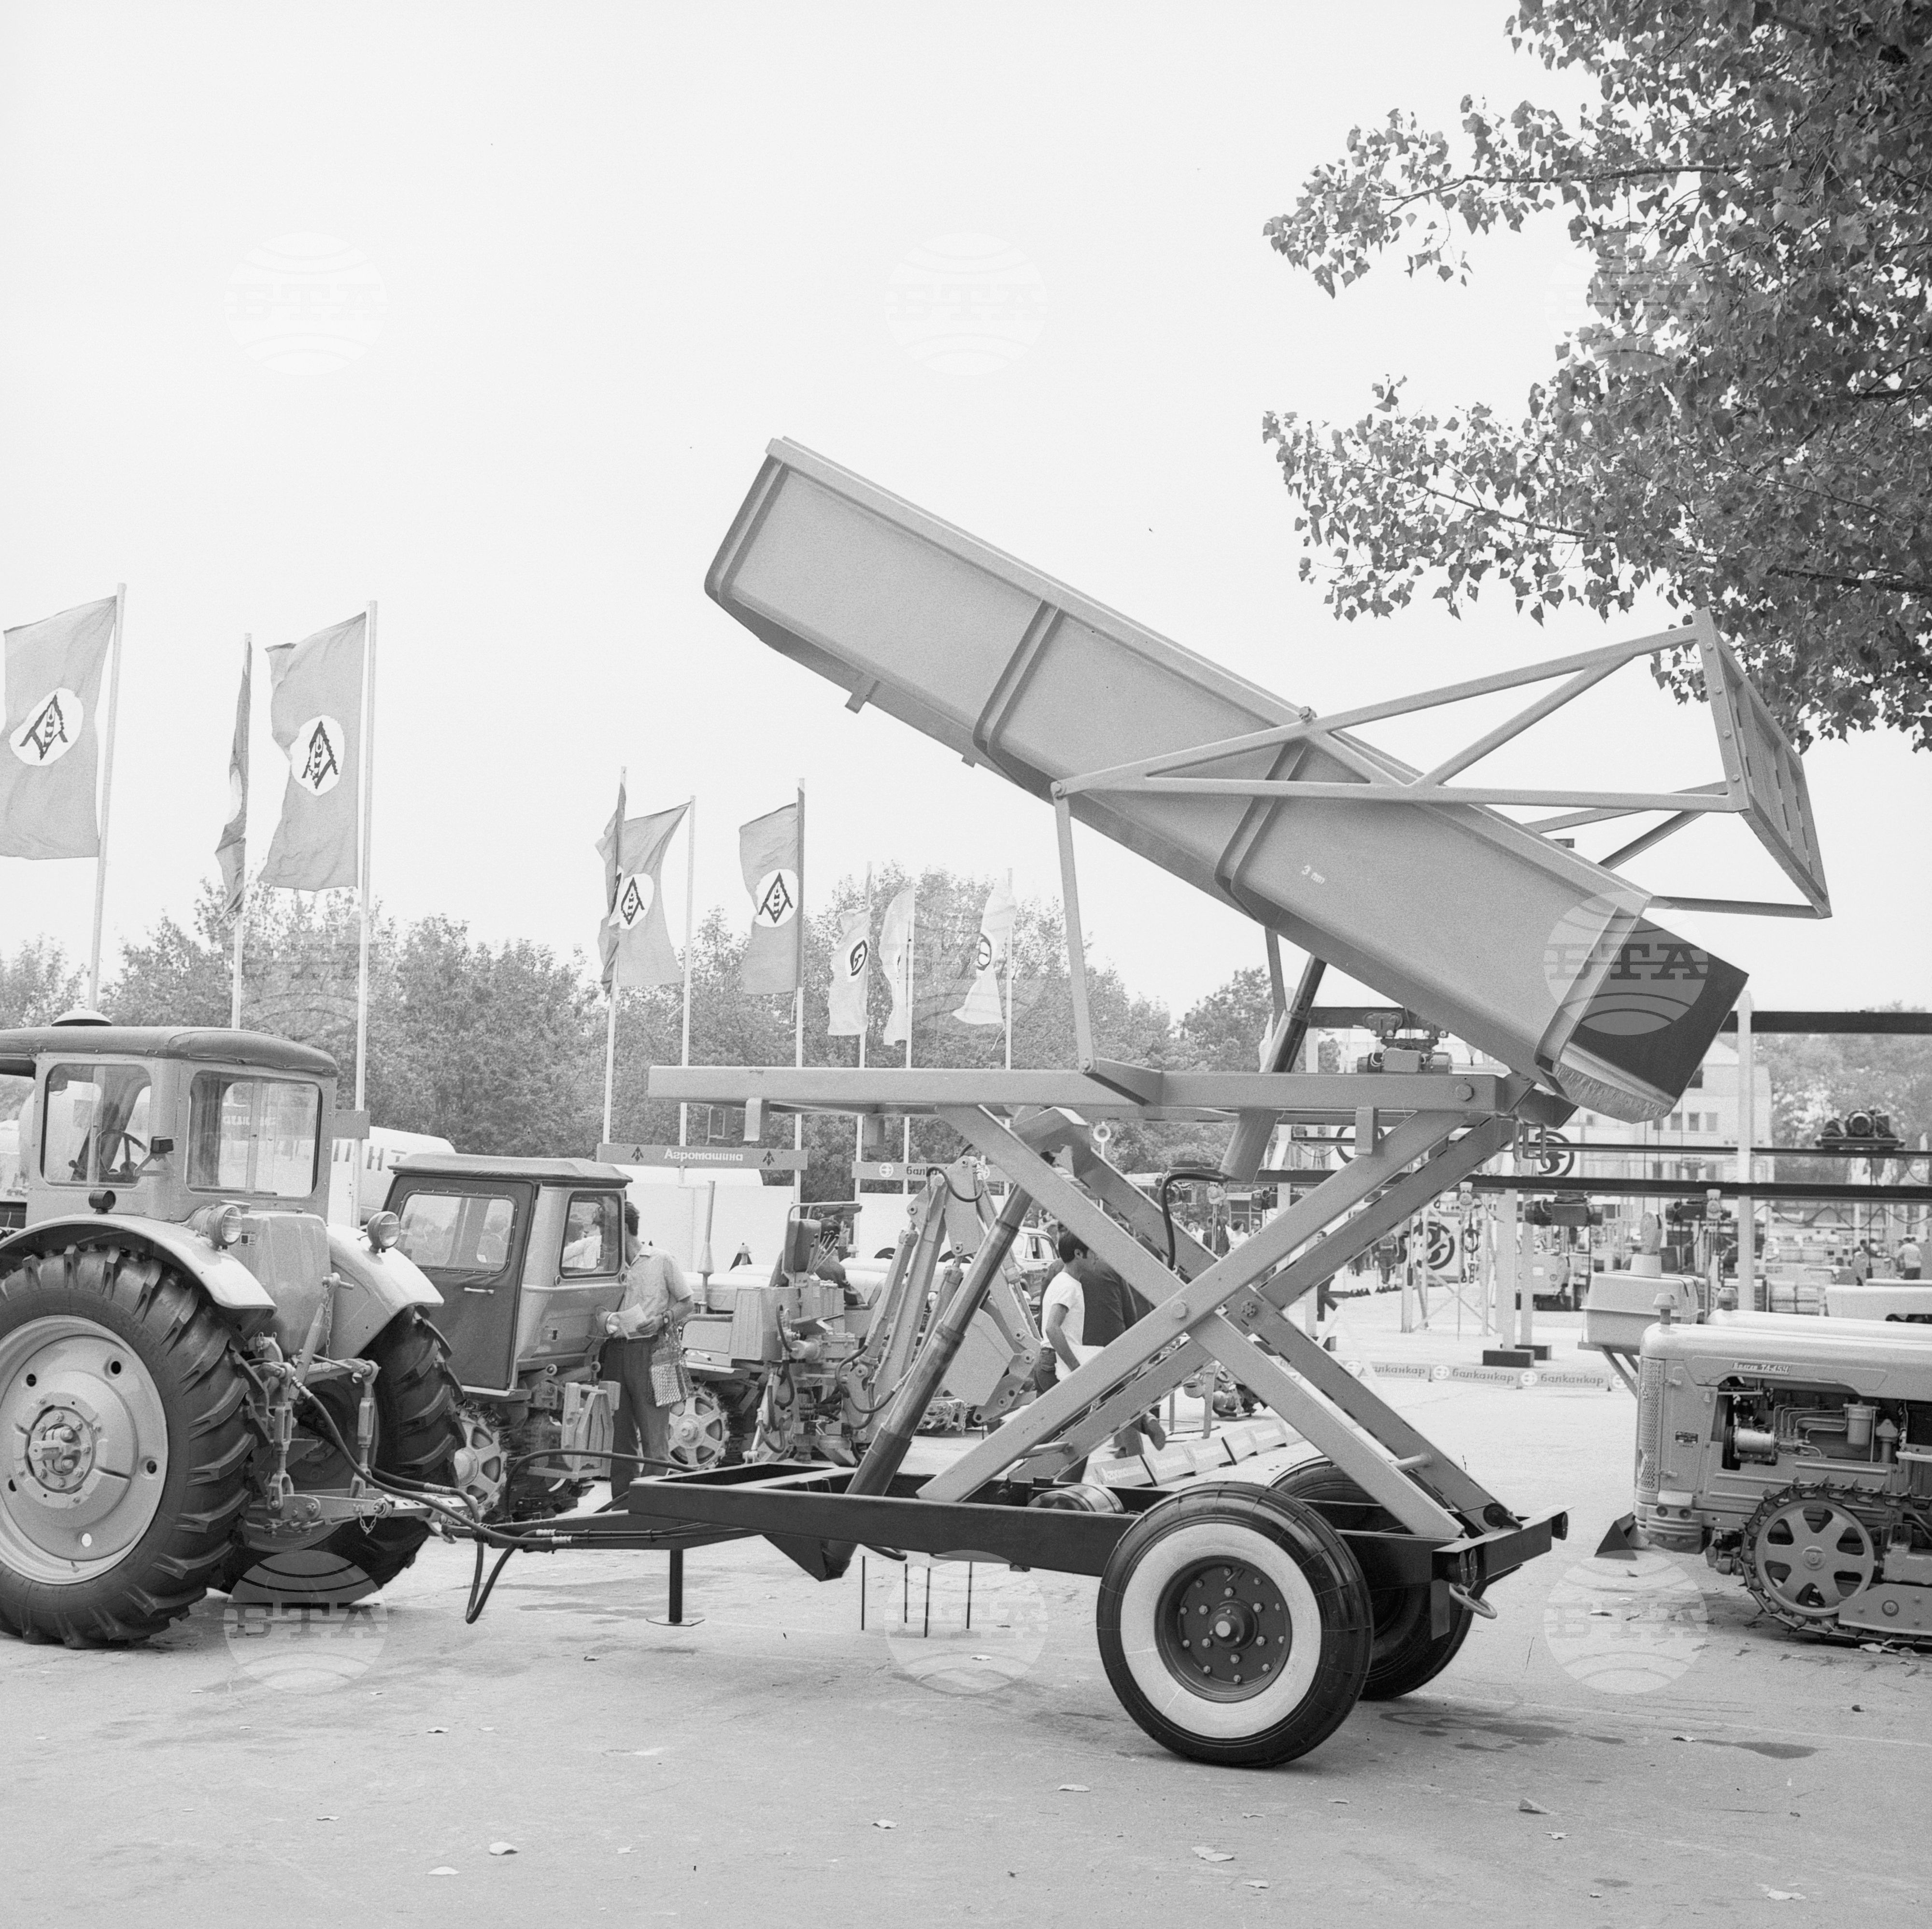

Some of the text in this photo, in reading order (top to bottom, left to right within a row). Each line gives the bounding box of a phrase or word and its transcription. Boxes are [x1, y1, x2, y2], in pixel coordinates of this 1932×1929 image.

[664, 1148, 743, 1162] Агромашина
[1452, 1368, 1514, 1382] балканкар
[1541, 1375, 1604, 1387] балканкар
